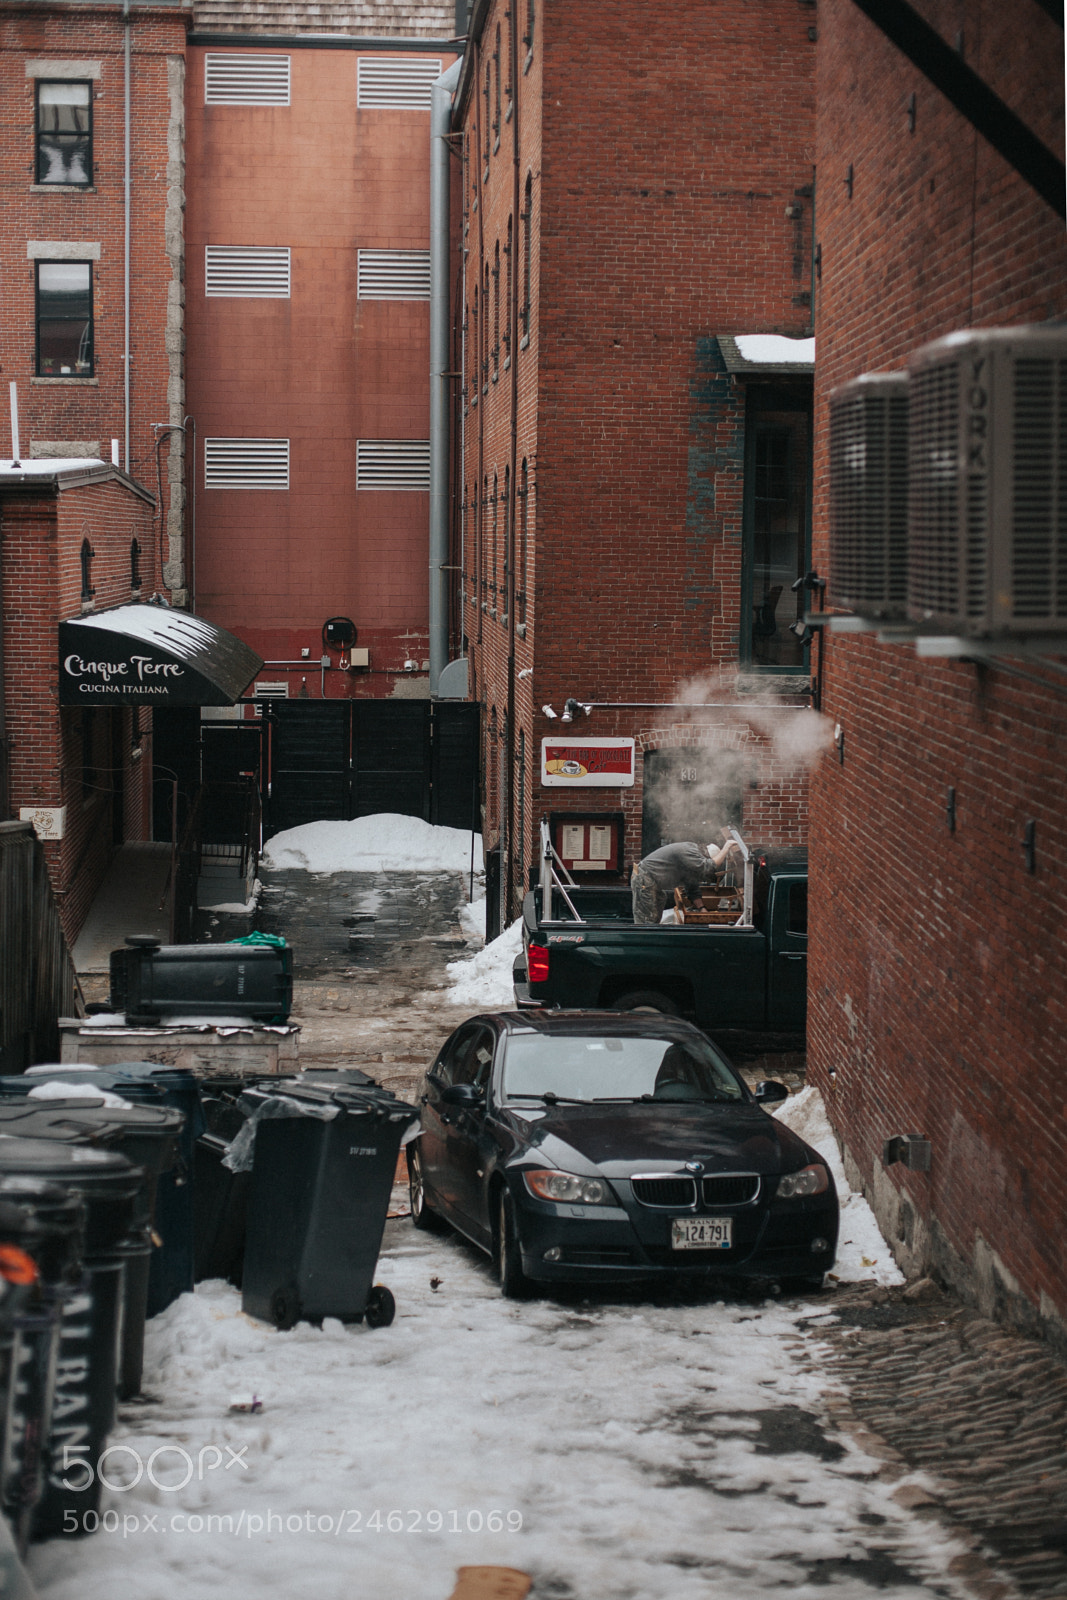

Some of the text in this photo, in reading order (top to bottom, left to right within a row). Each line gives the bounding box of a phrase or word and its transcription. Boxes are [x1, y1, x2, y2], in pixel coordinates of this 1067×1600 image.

[966, 358, 989, 467] YORK
[64, 654, 184, 682] Cinque Terre
[79, 684, 169, 694] CUCINA ITALIANA
[681, 768, 696, 781] 38
